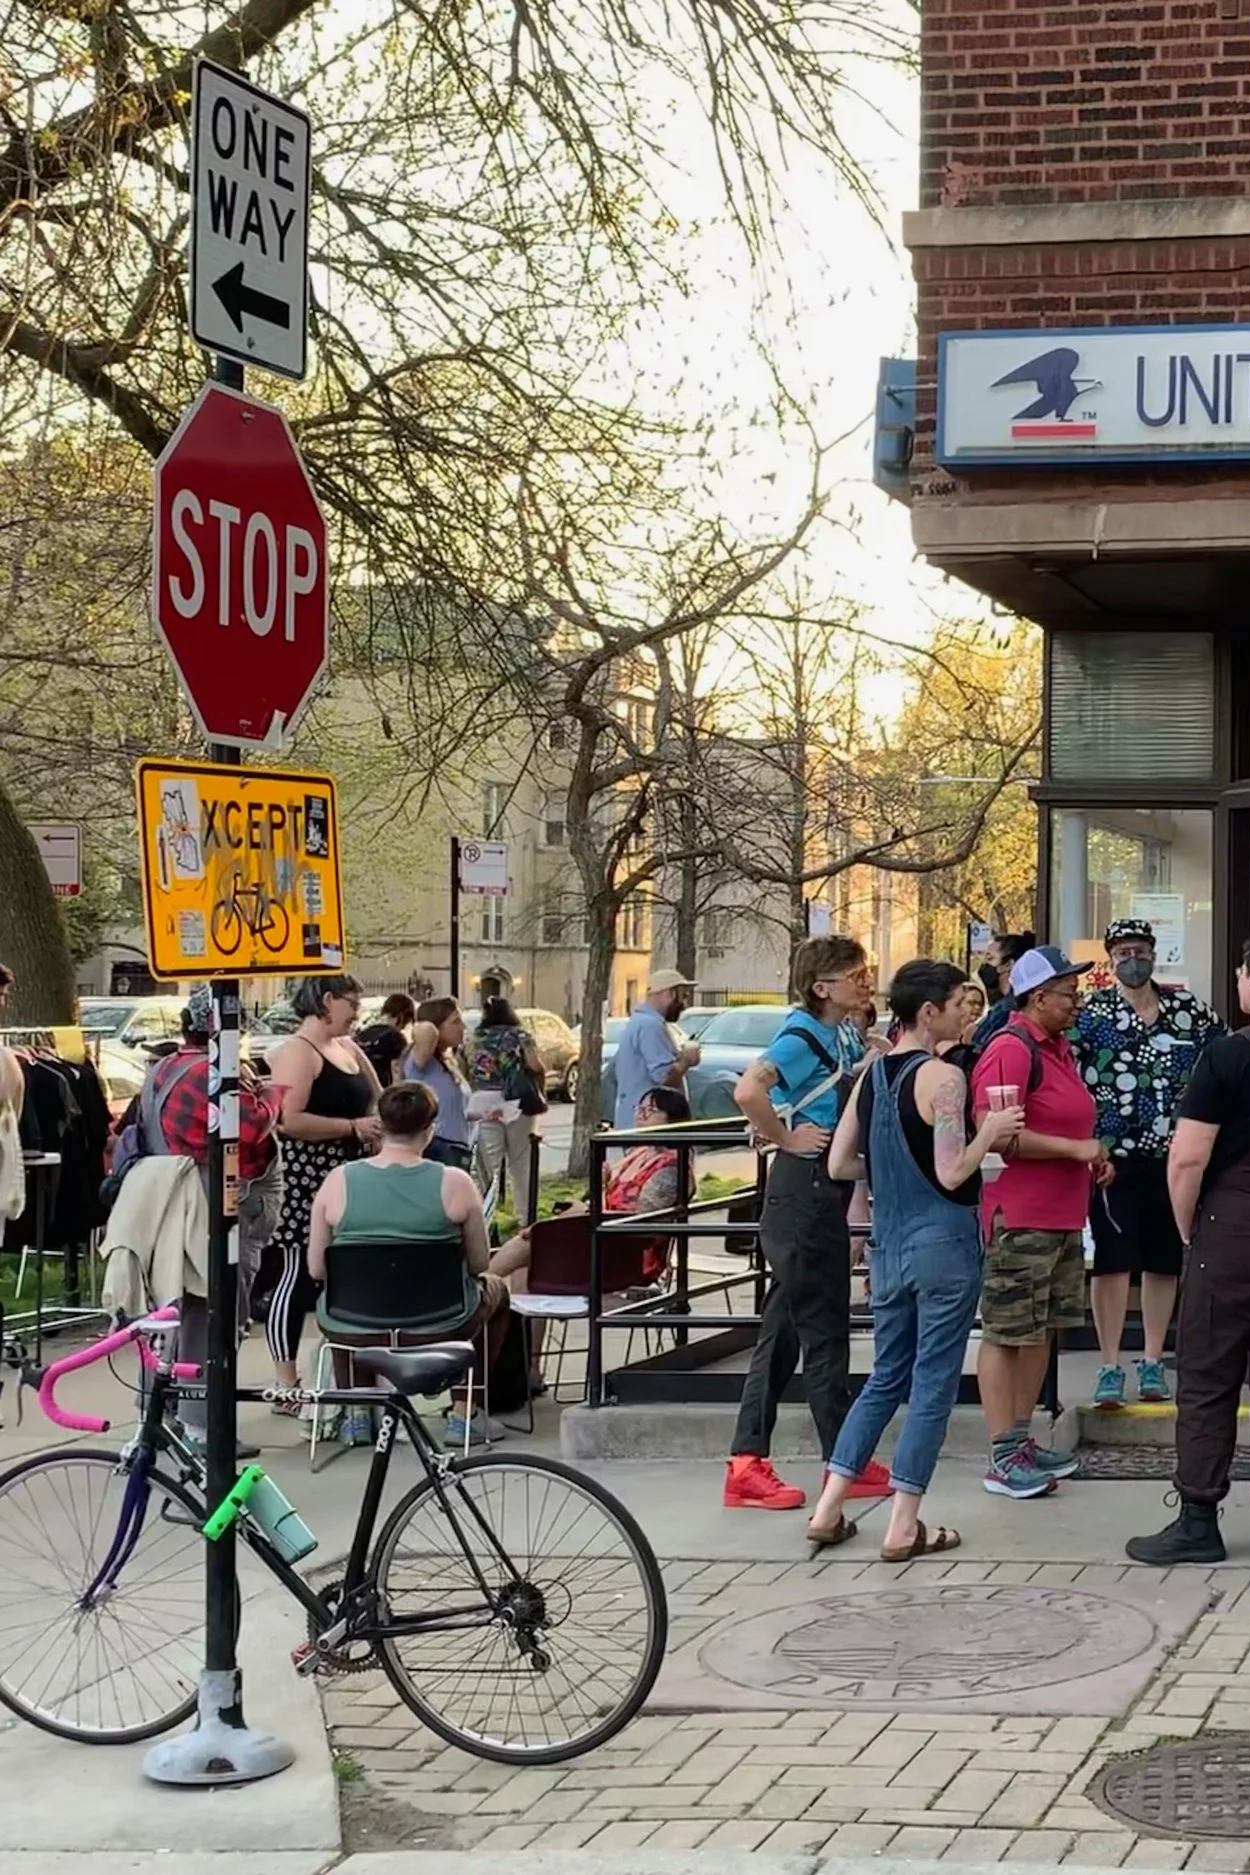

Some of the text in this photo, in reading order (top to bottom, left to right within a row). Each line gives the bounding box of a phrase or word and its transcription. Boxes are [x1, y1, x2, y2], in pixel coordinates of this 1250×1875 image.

[211, 96, 296, 193] ONE
[207, 169, 297, 264] WAY
[1081, 411, 1098, 420] TM
[168, 488, 318, 642] STOP
[200, 799, 303, 852] XCEPT
[261, 1387, 326, 1403] OAKLEY
[817, 1585, 1111, 1615] ROGERS
[765, 1671, 1014, 1700] PARK
